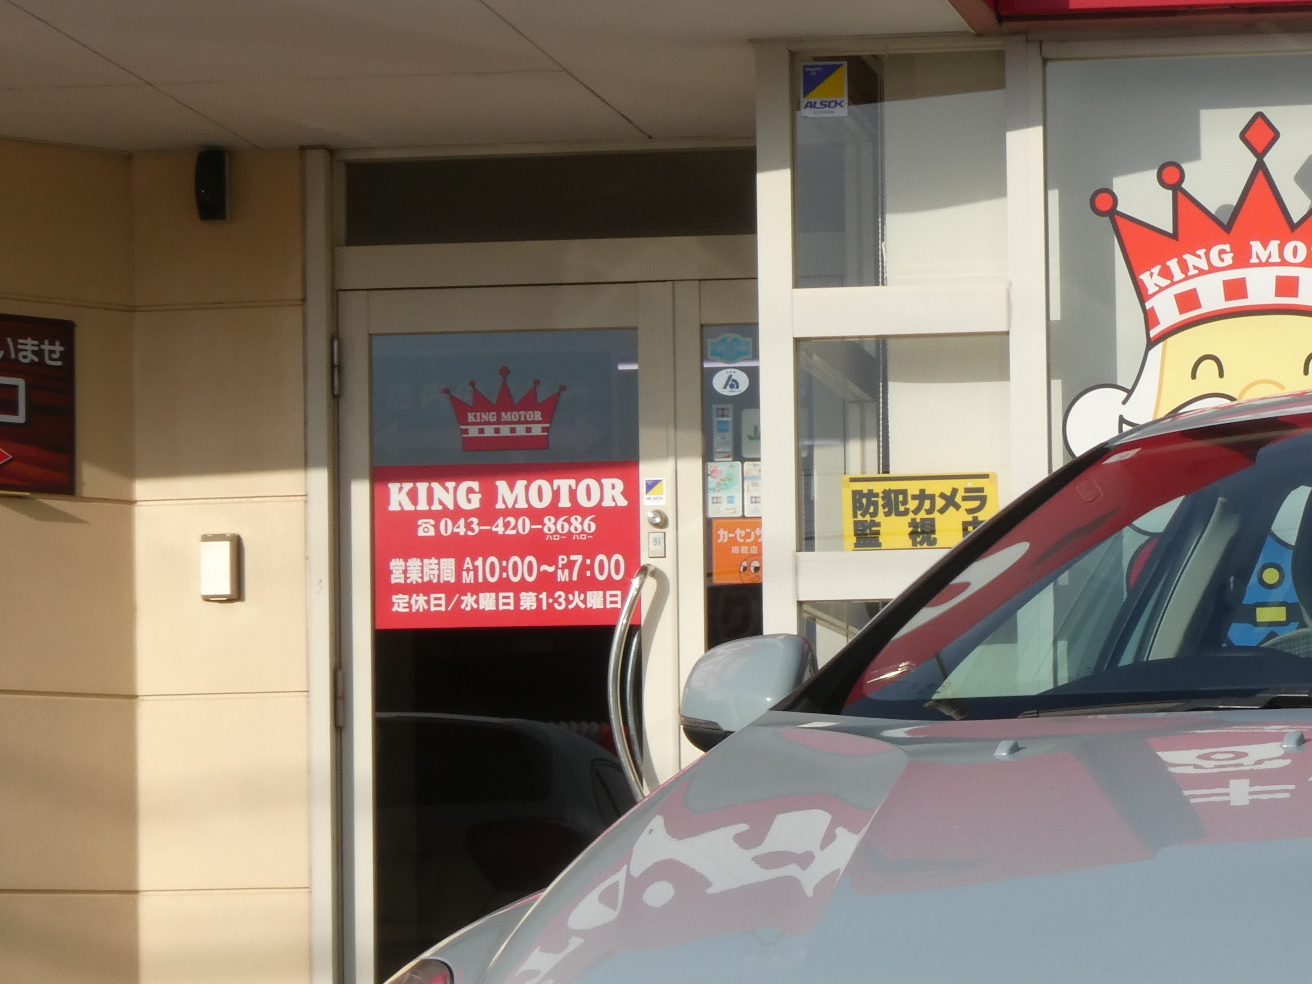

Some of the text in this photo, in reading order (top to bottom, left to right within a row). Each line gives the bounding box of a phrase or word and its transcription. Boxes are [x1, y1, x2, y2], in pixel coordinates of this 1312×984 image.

[804, 100, 845, 109] ALSOK
[1138, 243, 1234, 295] KING
[467, 410, 543, 422] KING MOTOR
[387, 478, 628, 511] KING MOTOR
[851, 487, 988, 518] 防犯カメラ
[439, 515, 597, 536] 043-420-8686
[389, 557, 456, 584] 営業時間
